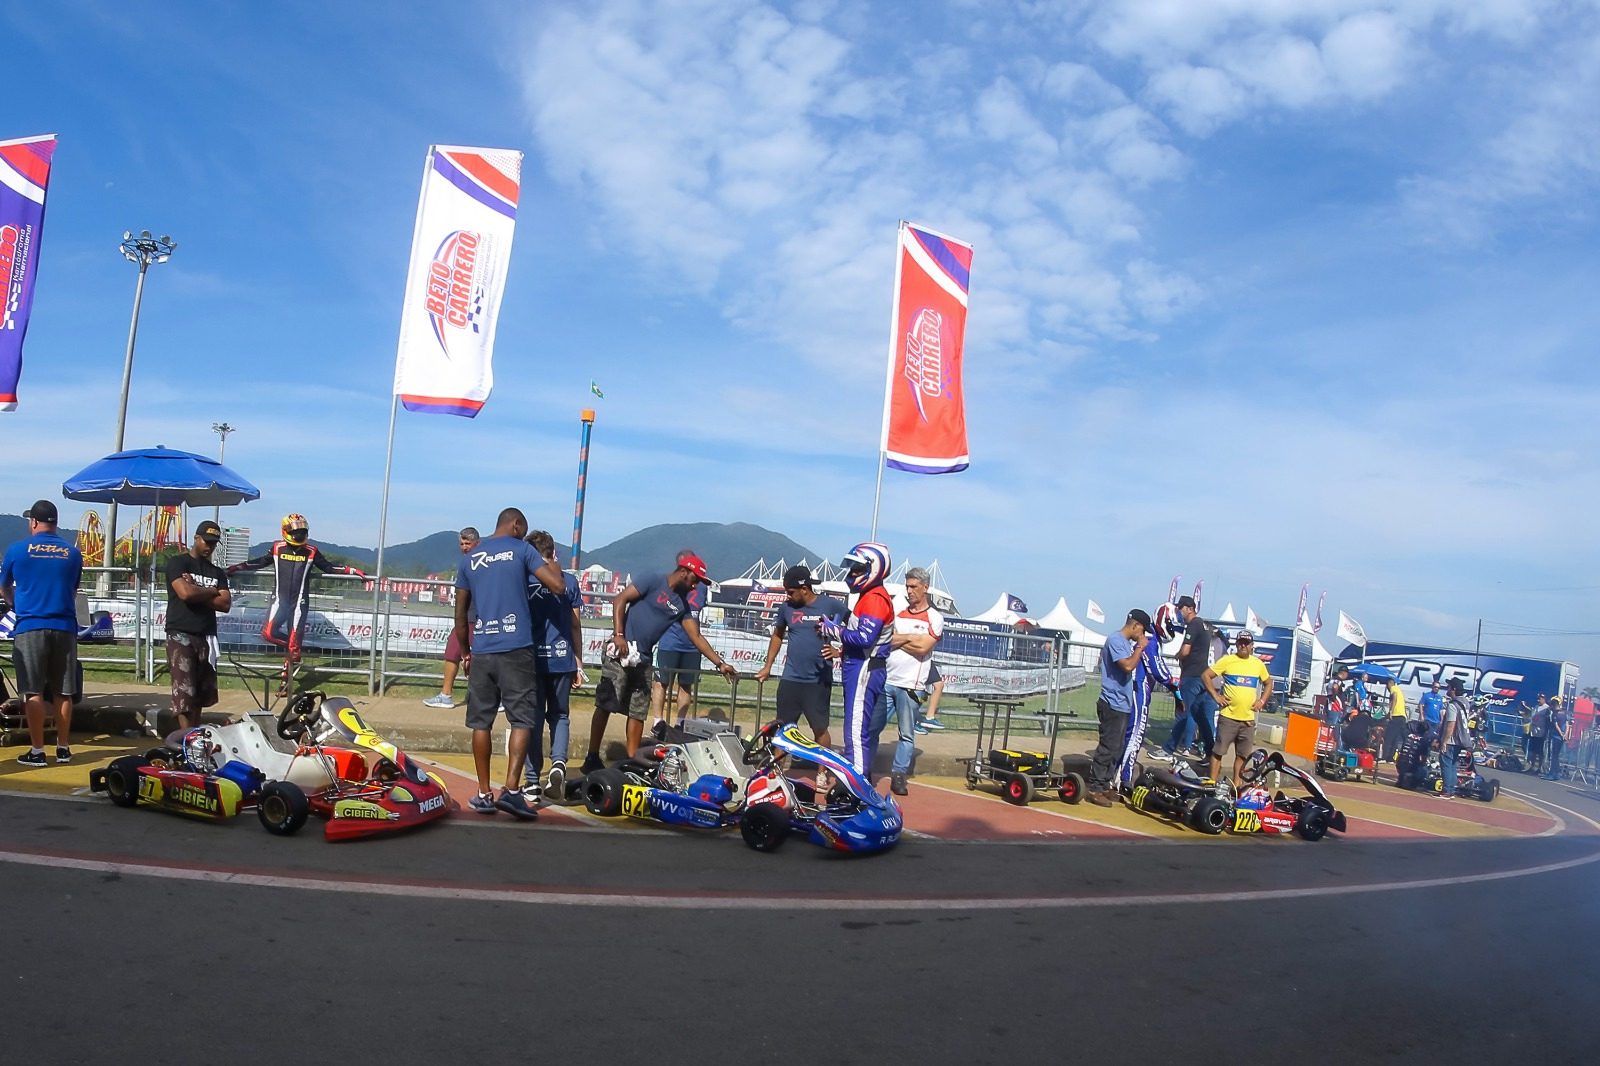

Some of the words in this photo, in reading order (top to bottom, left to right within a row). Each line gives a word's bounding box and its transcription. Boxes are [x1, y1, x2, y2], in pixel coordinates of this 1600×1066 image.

[426, 261, 451, 318] BETO
[448, 231, 478, 328] CARRERO
[906, 334, 921, 386] BETO
[922, 310, 940, 397] CARRERO
[347, 624, 402, 639] MGires
[409, 628, 449, 641] MGtir
[731, 649, 768, 662] MGtire
[1399, 659, 1525, 697] RBC
[1482, 694, 1515, 708] Sport
[148, 781, 155, 797] 7
[171, 785, 218, 812] CIBIEN
[419, 794, 445, 813] MEGA
[623, 788, 644, 816] 62
[344, 808, 379, 819] CIBIEN
[1237, 811, 1256, 832] 228
